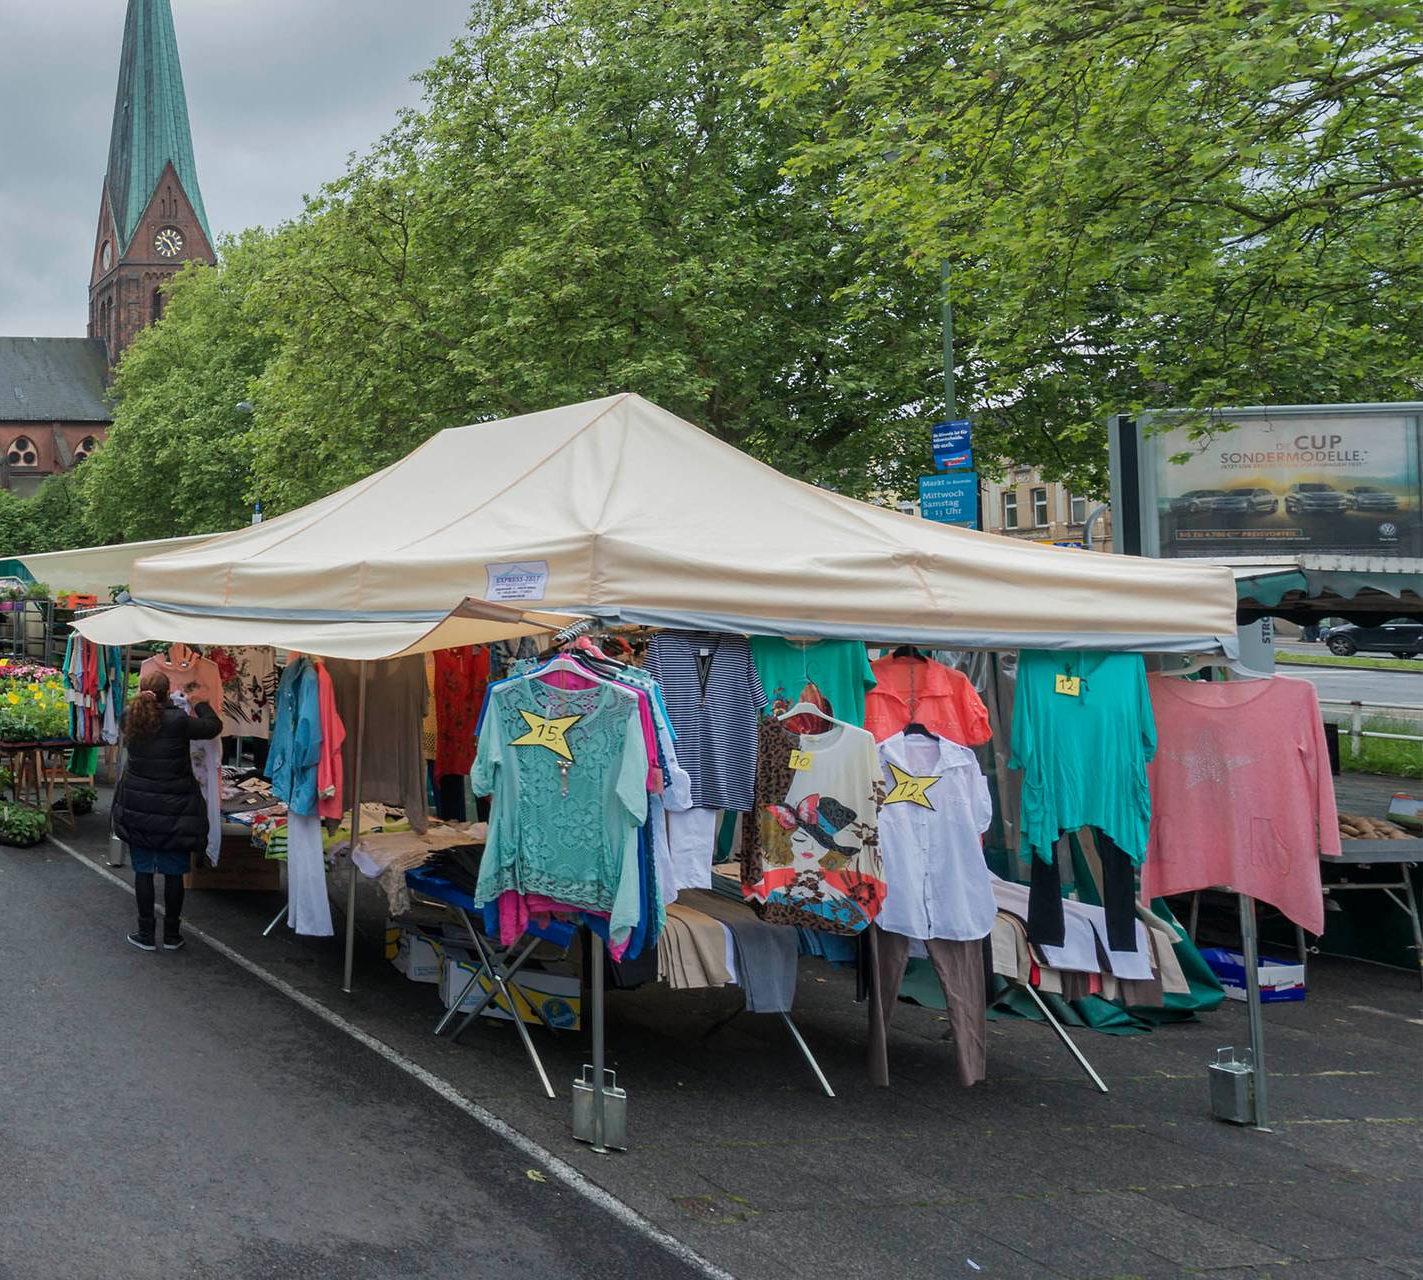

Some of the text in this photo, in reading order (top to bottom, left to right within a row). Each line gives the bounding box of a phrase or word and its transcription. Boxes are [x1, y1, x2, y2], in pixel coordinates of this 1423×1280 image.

[1294, 435, 1343, 450] CUP
[923, 479, 945, 488] Markt
[923, 489, 964, 500] Mittwoch
[923, 500, 960, 509] Samstag
[945, 507, 962, 516] Uhr
[792, 755, 810, 767] 10
